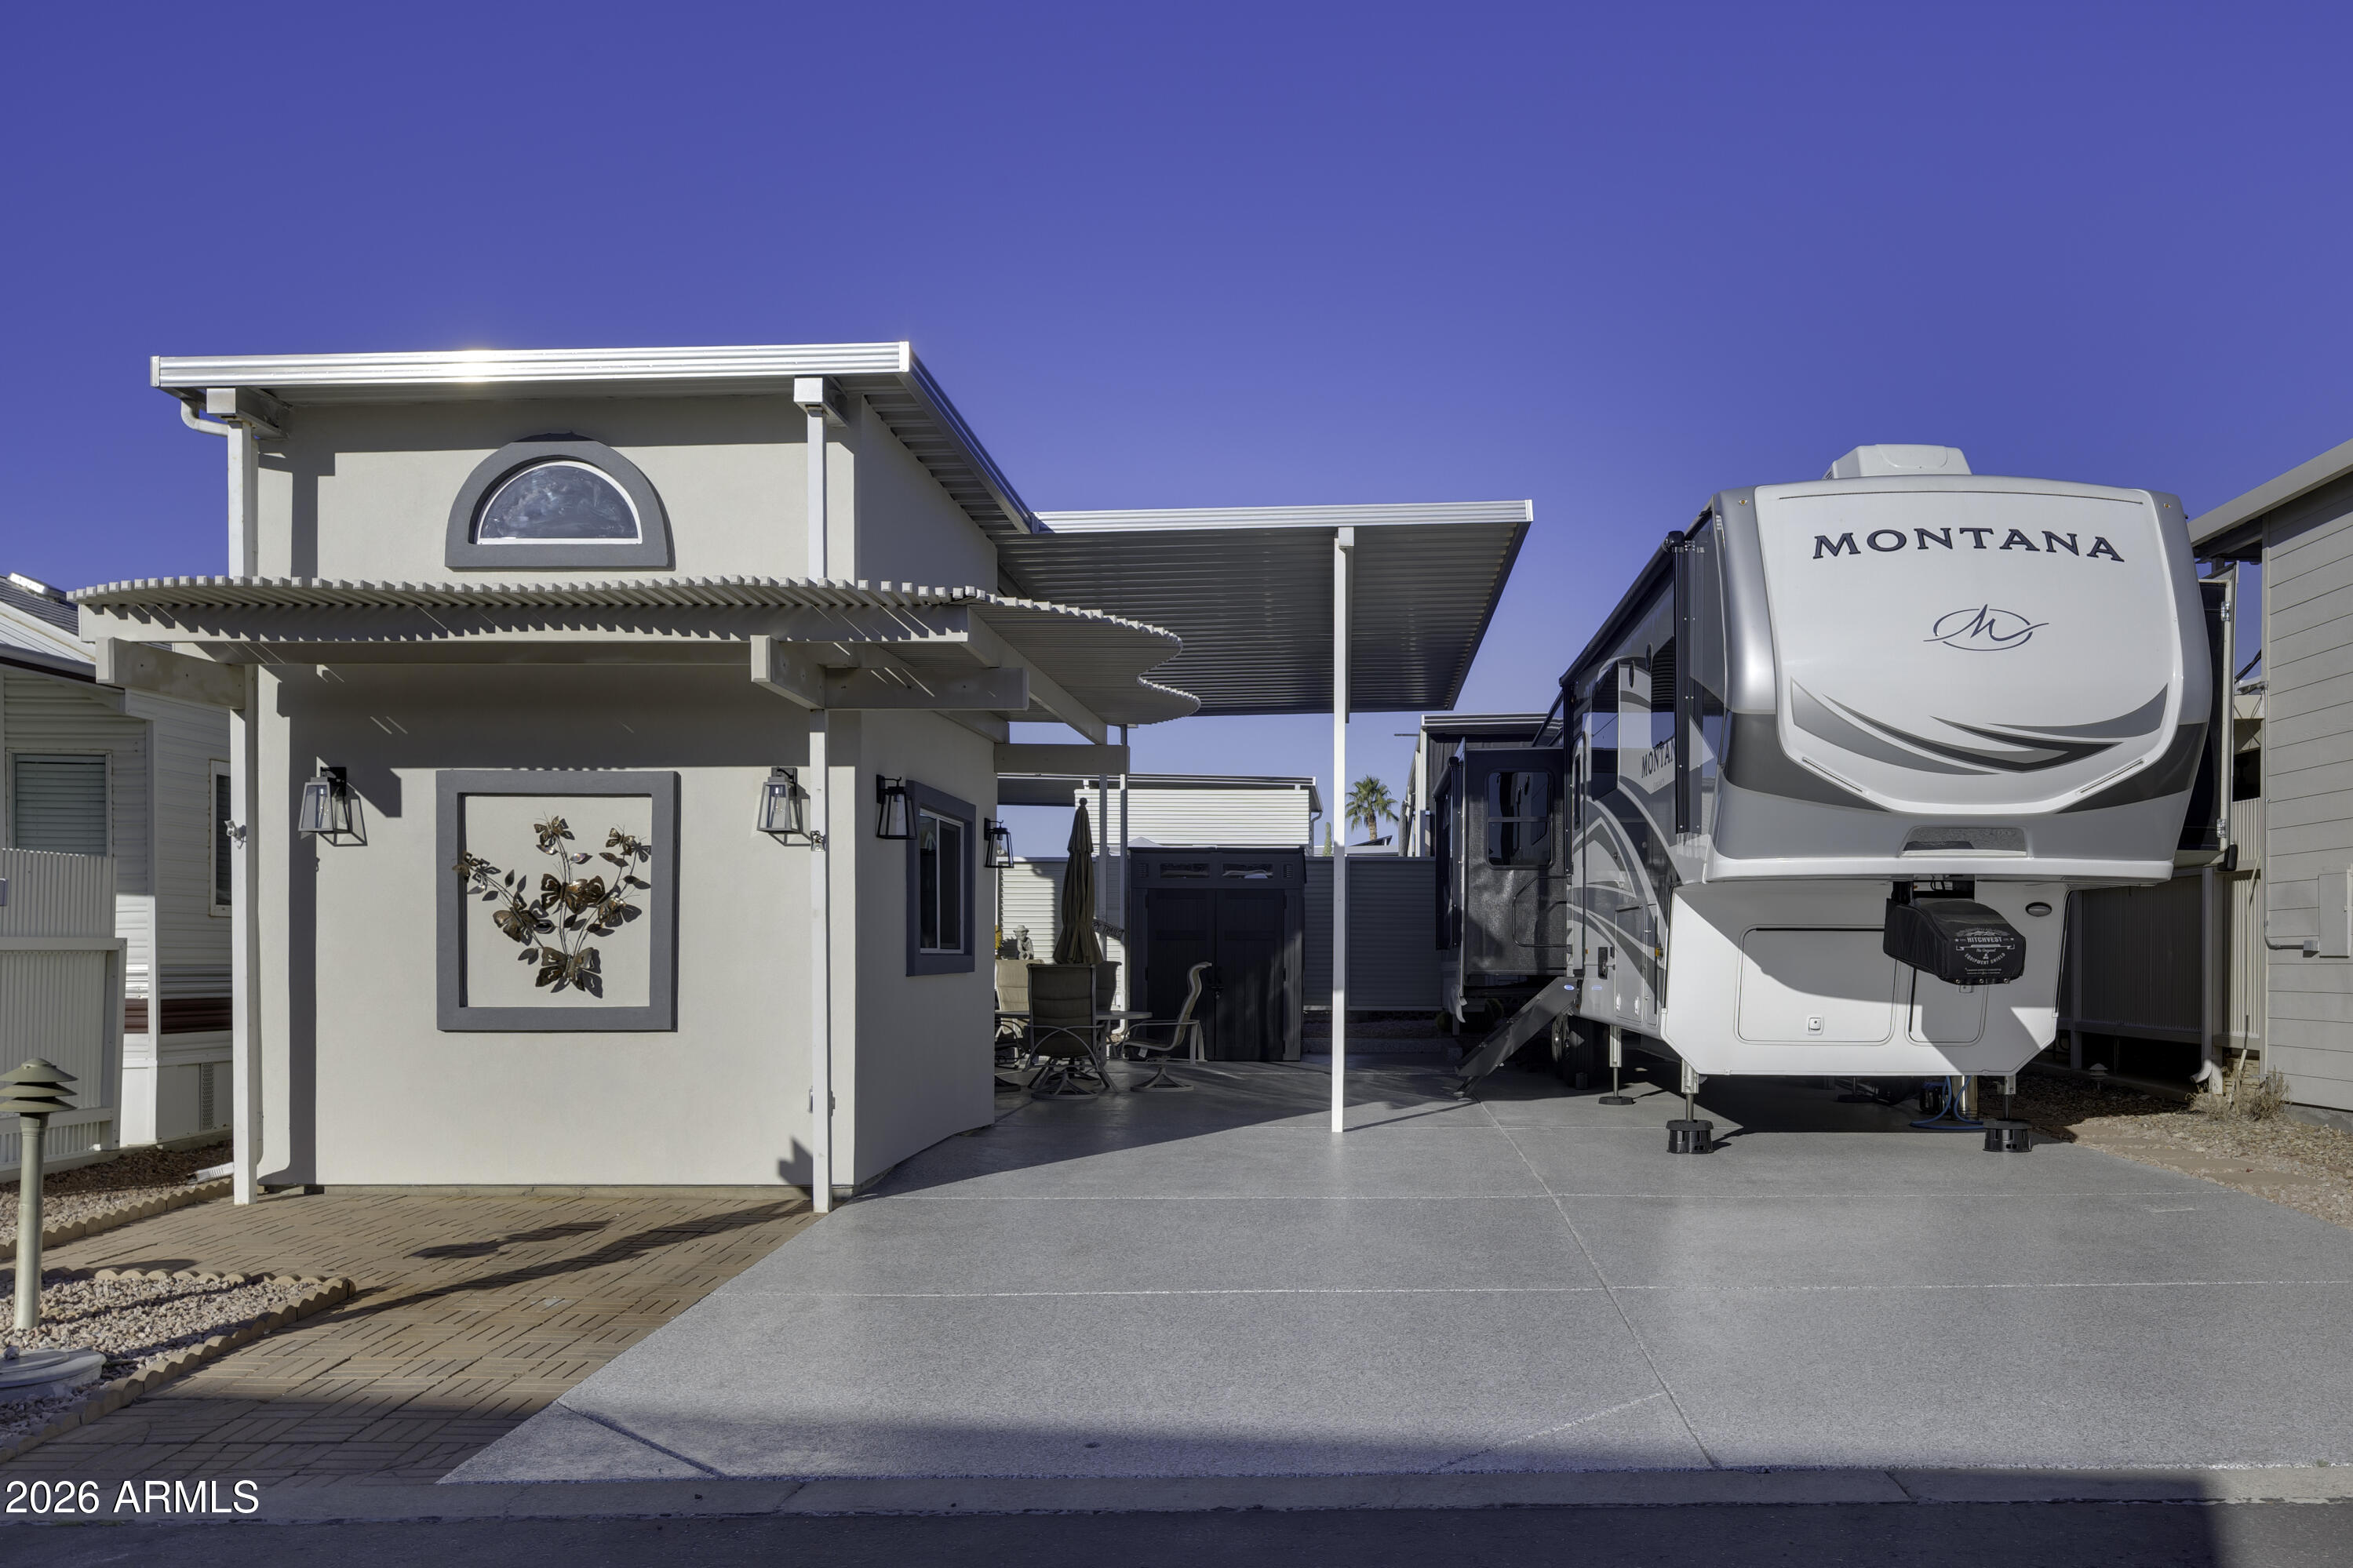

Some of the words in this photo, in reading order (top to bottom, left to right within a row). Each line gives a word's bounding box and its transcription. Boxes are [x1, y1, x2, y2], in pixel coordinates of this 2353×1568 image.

[1812, 527, 2125, 563] MONTANA
[1641, 739, 1675, 778] MONTAN
[1965, 953, 1989, 965] EQUIPMENT
[1990, 952, 2005, 964] SHIELD
